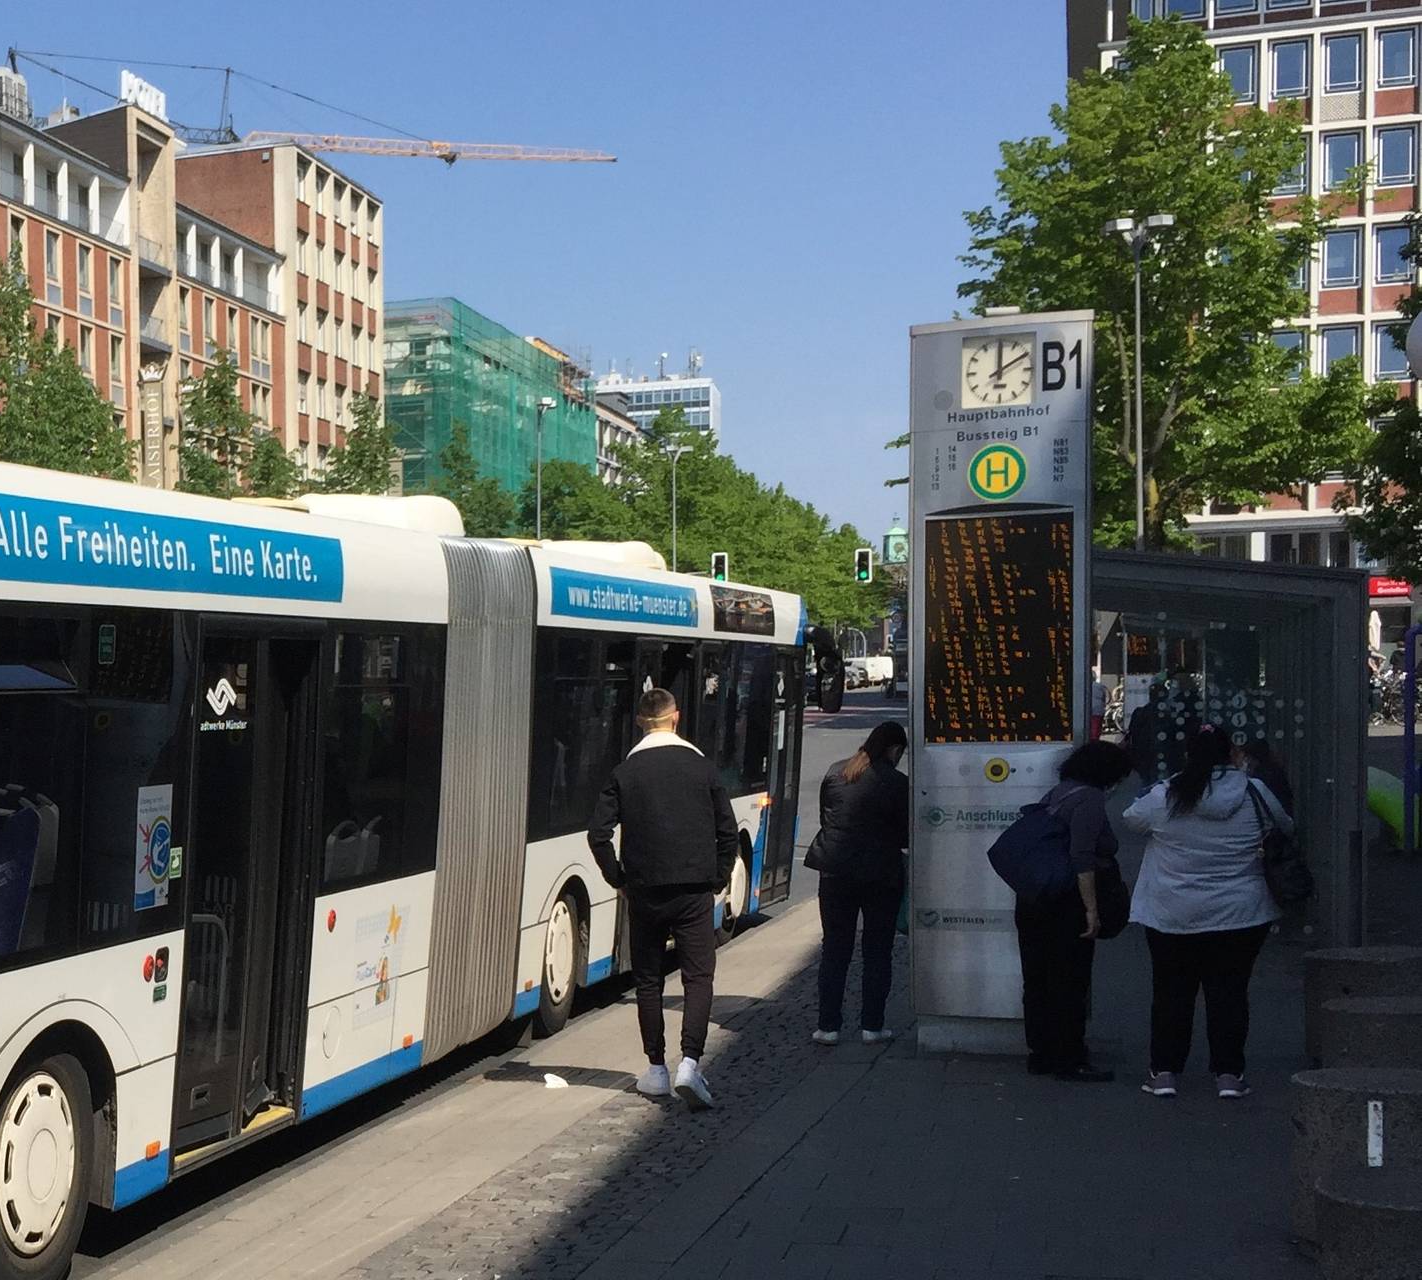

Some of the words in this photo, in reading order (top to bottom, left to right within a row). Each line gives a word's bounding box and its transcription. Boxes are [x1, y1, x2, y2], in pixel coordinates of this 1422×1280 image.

[1041, 338, 1082, 392] B1
[947, 404, 1051, 424] Hauptbahnhof
[147, 387, 161, 488] AISERHOF
[956, 429, 1018, 442] Bussteig
[1023, 426, 1039, 438] B1
[986, 456, 1009, 489] H
[58, 514, 196, 573] Freiheiten.
[209, 533, 254, 577] Eine
[260, 539, 318, 583] Karte.
[568, 586, 688, 618] www.stadtwerke-muenster.de
